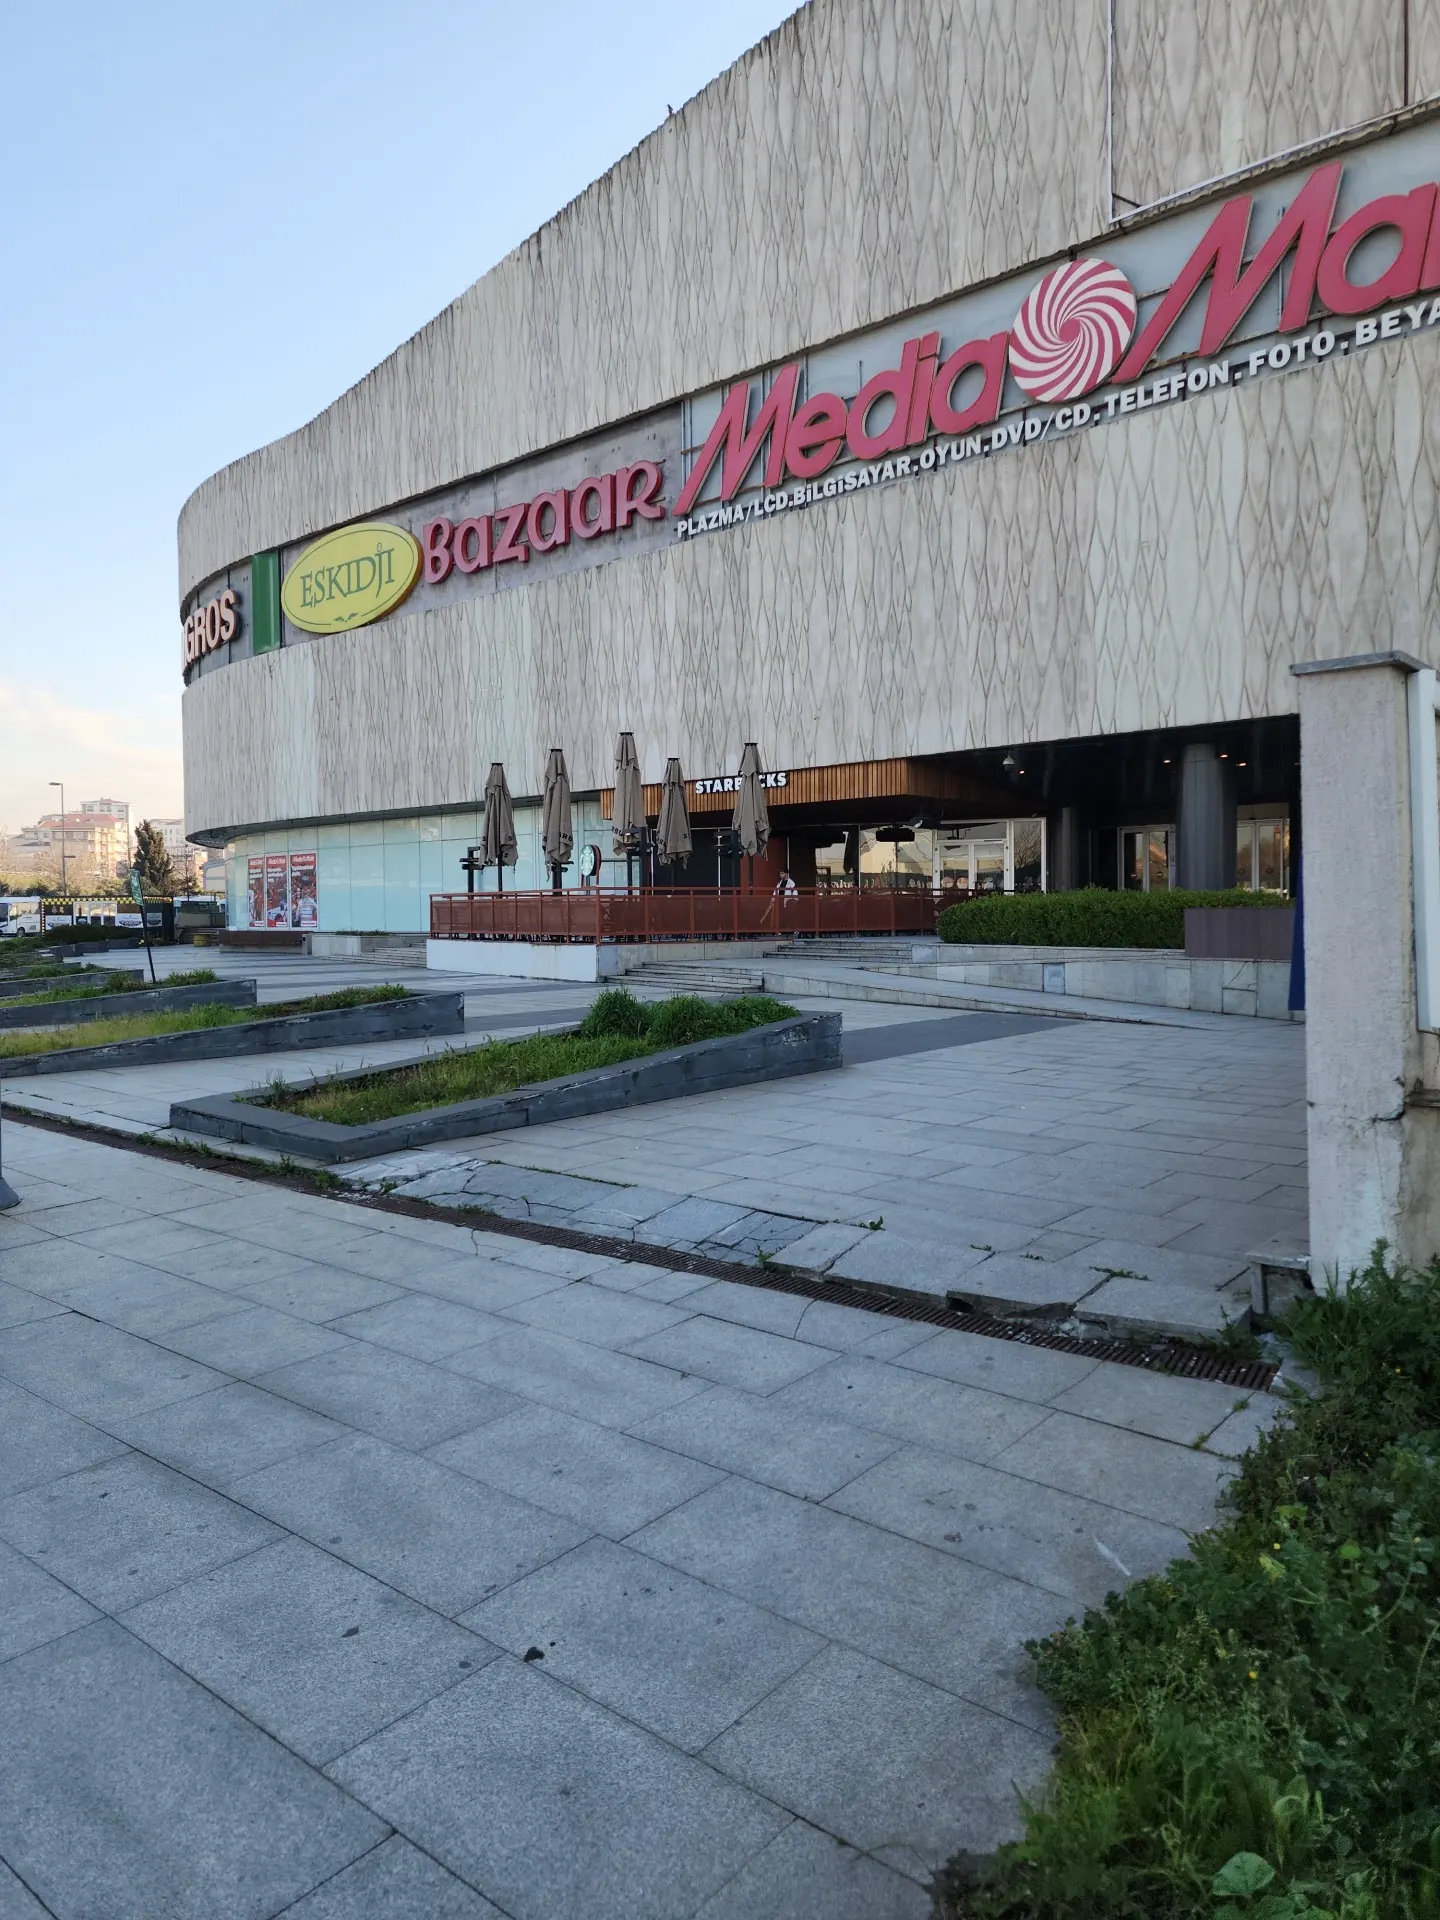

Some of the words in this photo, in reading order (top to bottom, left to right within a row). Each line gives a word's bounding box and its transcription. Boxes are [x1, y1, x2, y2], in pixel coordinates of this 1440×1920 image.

[672, 332, 1011, 516] Media
[1111, 161, 1440, 383] Ma
[695, 772, 787, 794] STARBCKS
